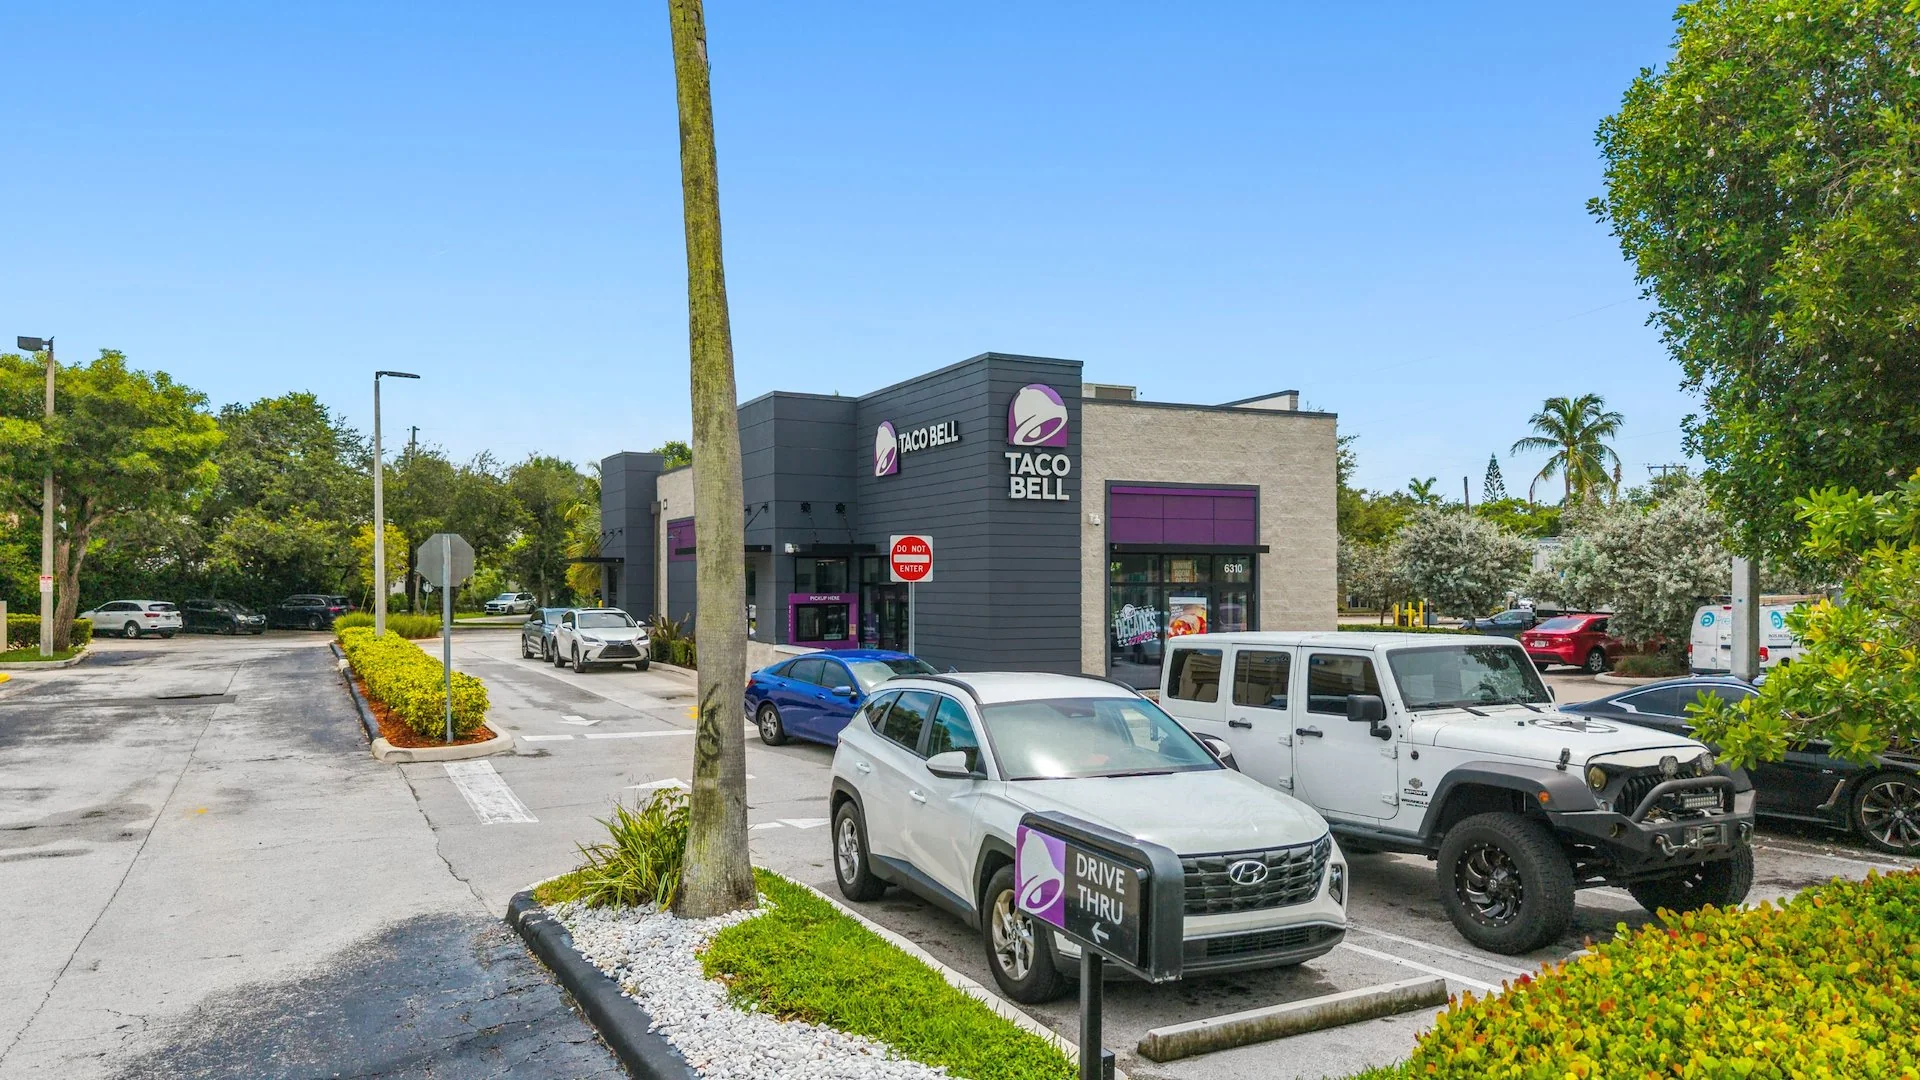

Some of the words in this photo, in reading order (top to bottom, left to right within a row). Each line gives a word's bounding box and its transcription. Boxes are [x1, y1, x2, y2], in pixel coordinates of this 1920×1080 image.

[899, 427, 928, 453] TACO
[929, 420, 959, 445] BELL
[1005, 452, 1071, 477] TACO
[1010, 477, 1070, 500] BELL
[1224, 563, 1243, 574] 6310
[1115, 612, 1157, 639] DECADES
[1076, 853, 1125, 895] DRIVE
[1077, 884, 1123, 925] THRU
